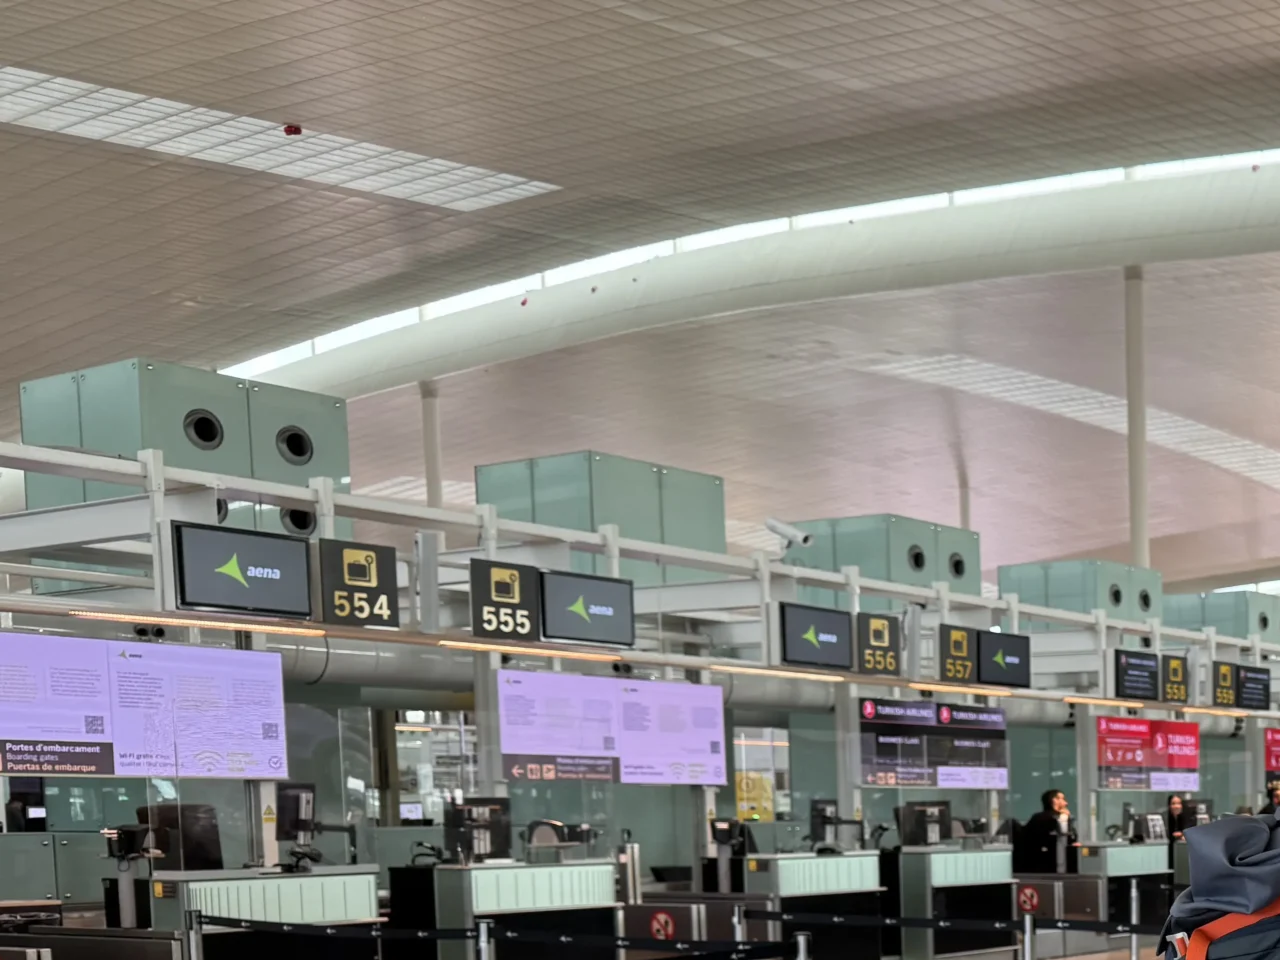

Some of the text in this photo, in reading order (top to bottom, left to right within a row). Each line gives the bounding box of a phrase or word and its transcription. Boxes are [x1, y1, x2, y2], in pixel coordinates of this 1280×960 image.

[247, 565, 281, 580] aena
[333, 590, 392, 620] 554
[482, 605, 531, 634] 555
[864, 650, 896, 671] 556
[945, 659, 972, 679] 557
[6, 742, 100, 754] Portes d'embarcament
[6, 753, 59, 762] Boarding gates
[7, 762, 96, 773] Puertas de embarque
